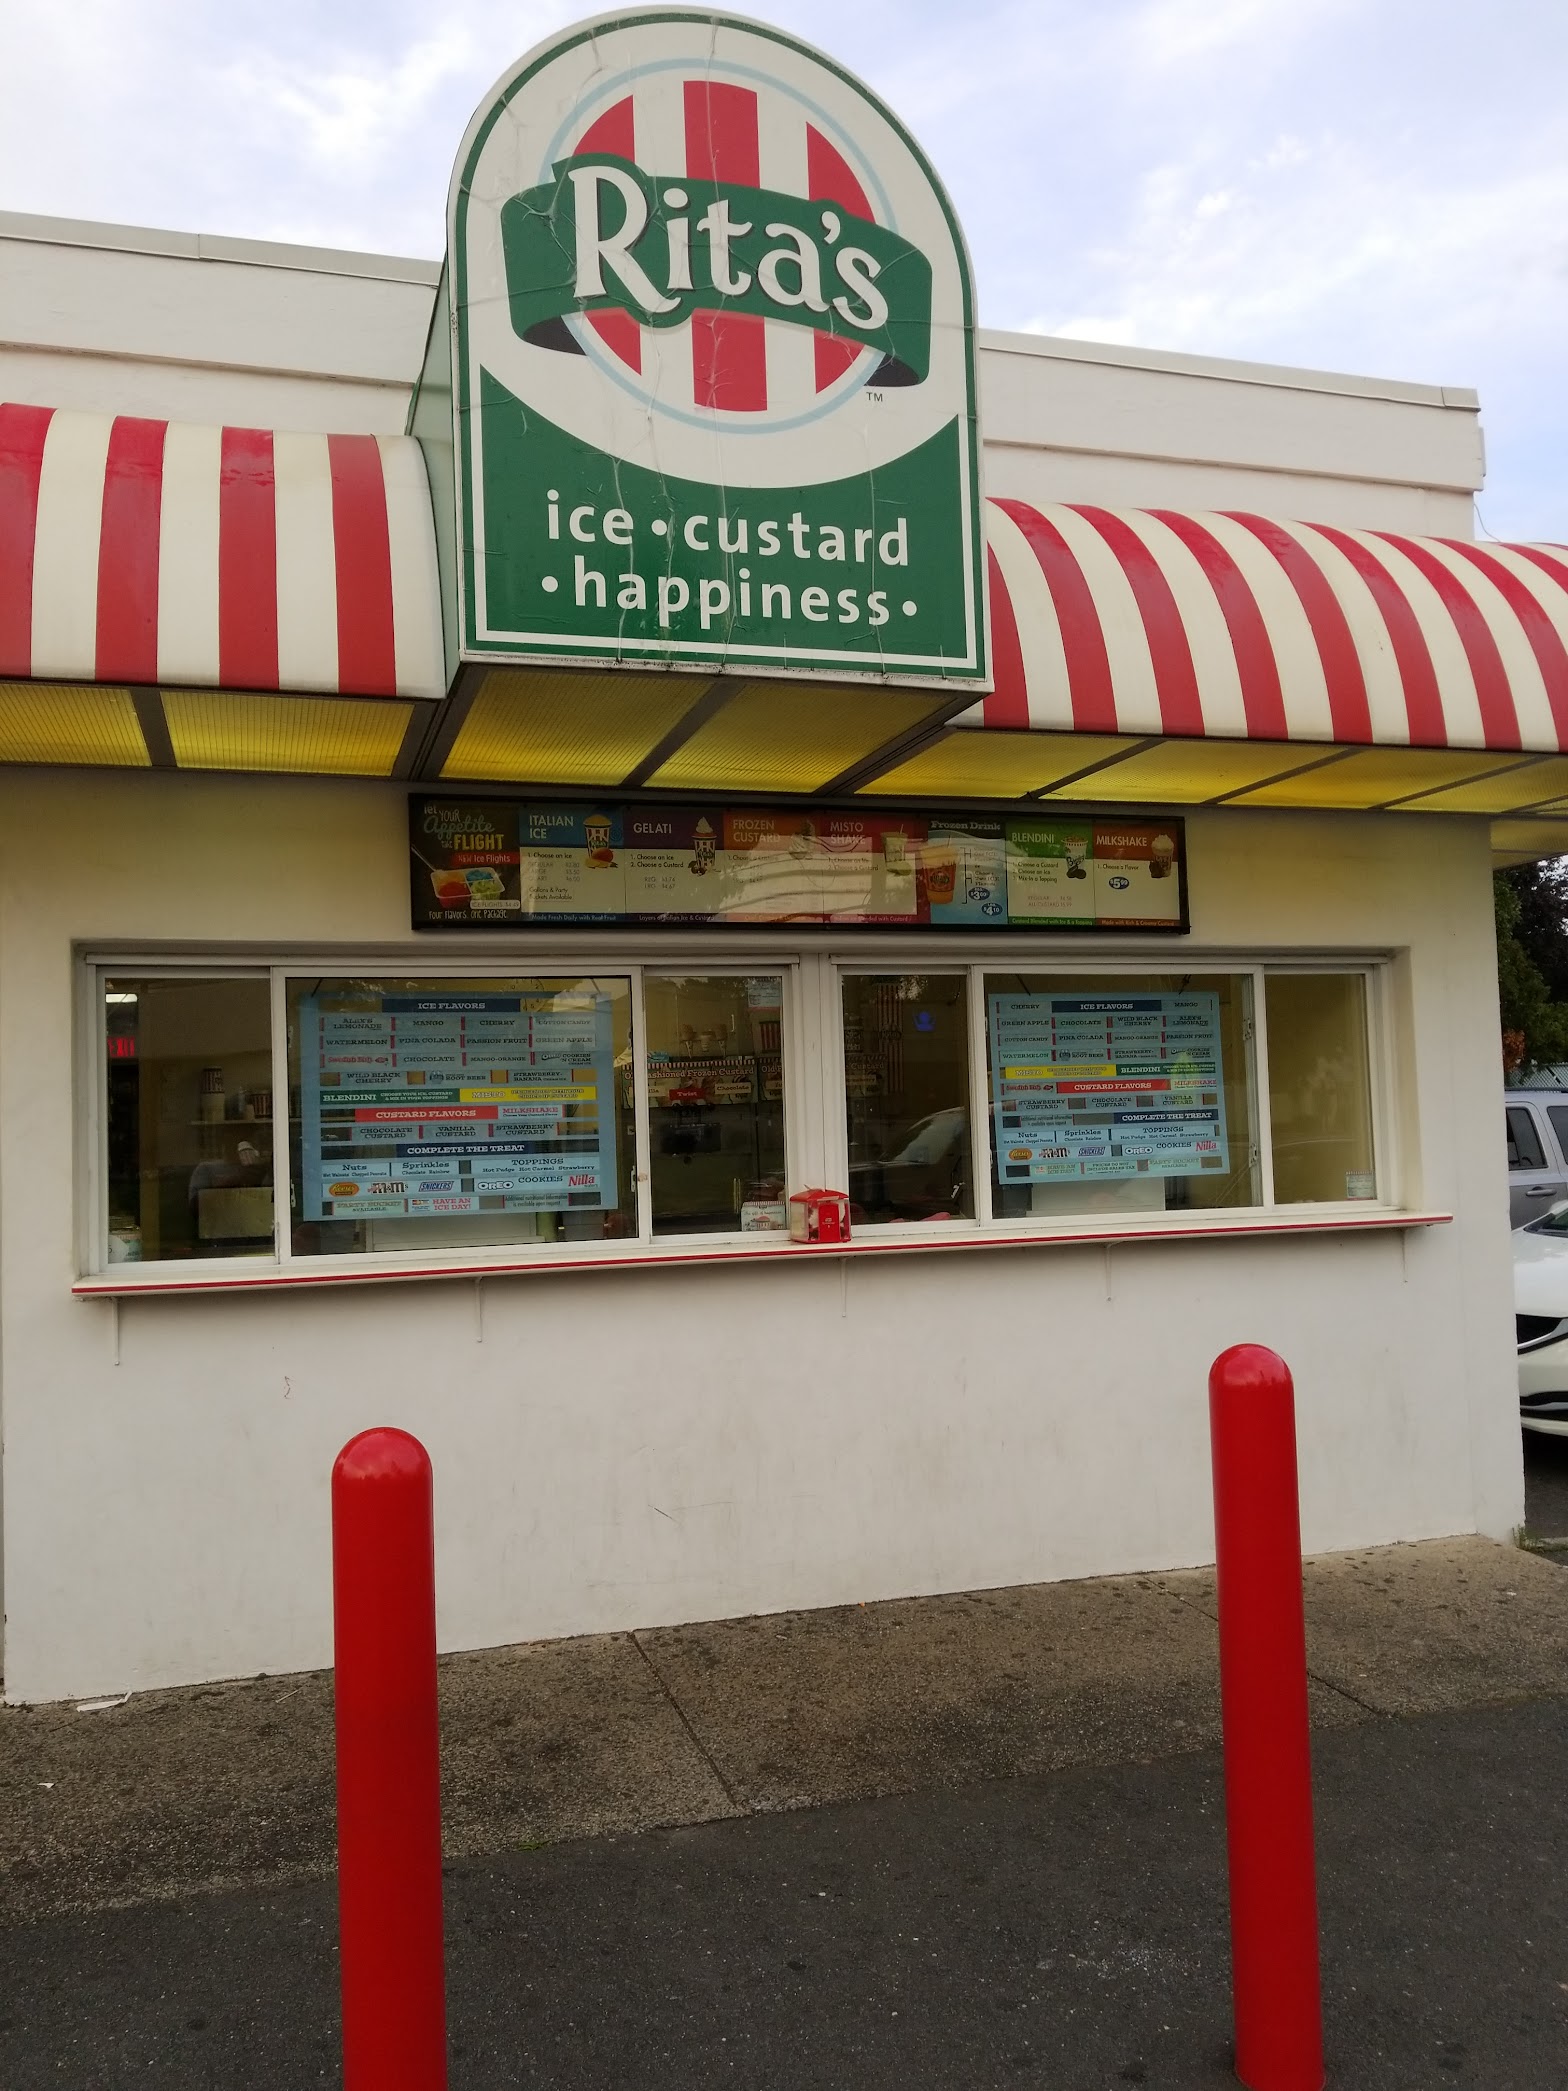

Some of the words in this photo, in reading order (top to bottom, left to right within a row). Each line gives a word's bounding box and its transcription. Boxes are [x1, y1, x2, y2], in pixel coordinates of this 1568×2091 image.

[568, 164, 890, 331] Rita's
[866, 391, 884, 403] TM
[548, 490, 633, 546] ice
[683, 518, 910, 567] custard
[574, 555, 889, 631] happiness
[439, 809, 461, 822] YOUR
[529, 815, 574, 827] ITALIAN
[424, 815, 495, 840] Appetite
[633, 822, 672, 834] GELATI
[733, 819, 775, 830] FROZEN
[830, 821, 864, 832] MISTO
[931, 820, 969, 829] Frozen
[529, 828, 547, 839] ICE
[733, 832, 781, 842] CUSTARD
[831, 834, 866, 844] SHAKE
[1011, 832, 1055, 843] BLENDINI
[453, 833, 504, 851] FLIGHT
[1096, 835, 1147, 847] MILKSHAKE
[474, 855, 485, 863] Ice
[486, 854, 511, 864] Flights
[418, 1002, 437, 1010] ICE
[438, 1002, 486, 1010] FLAVORS
[687, 1069, 717, 1078] Frozen
[718, 1067, 754, 1076] Custard
[322, 1094, 377, 1102] BLENDINI
[1064, 1129, 1102, 1137] Sprinkles
[407, 1146, 464, 1154] COMPLETE
[1125, 1146, 1153, 1155] OREO
[1156, 1141, 1192, 1149] COOKIES
[402, 1161, 450, 1170] Sprinkles
[420, 1181, 451, 1191] SNICKERS
[477, 1180, 514, 1190] OREO
[568, 1174, 595, 1187] Nilla
